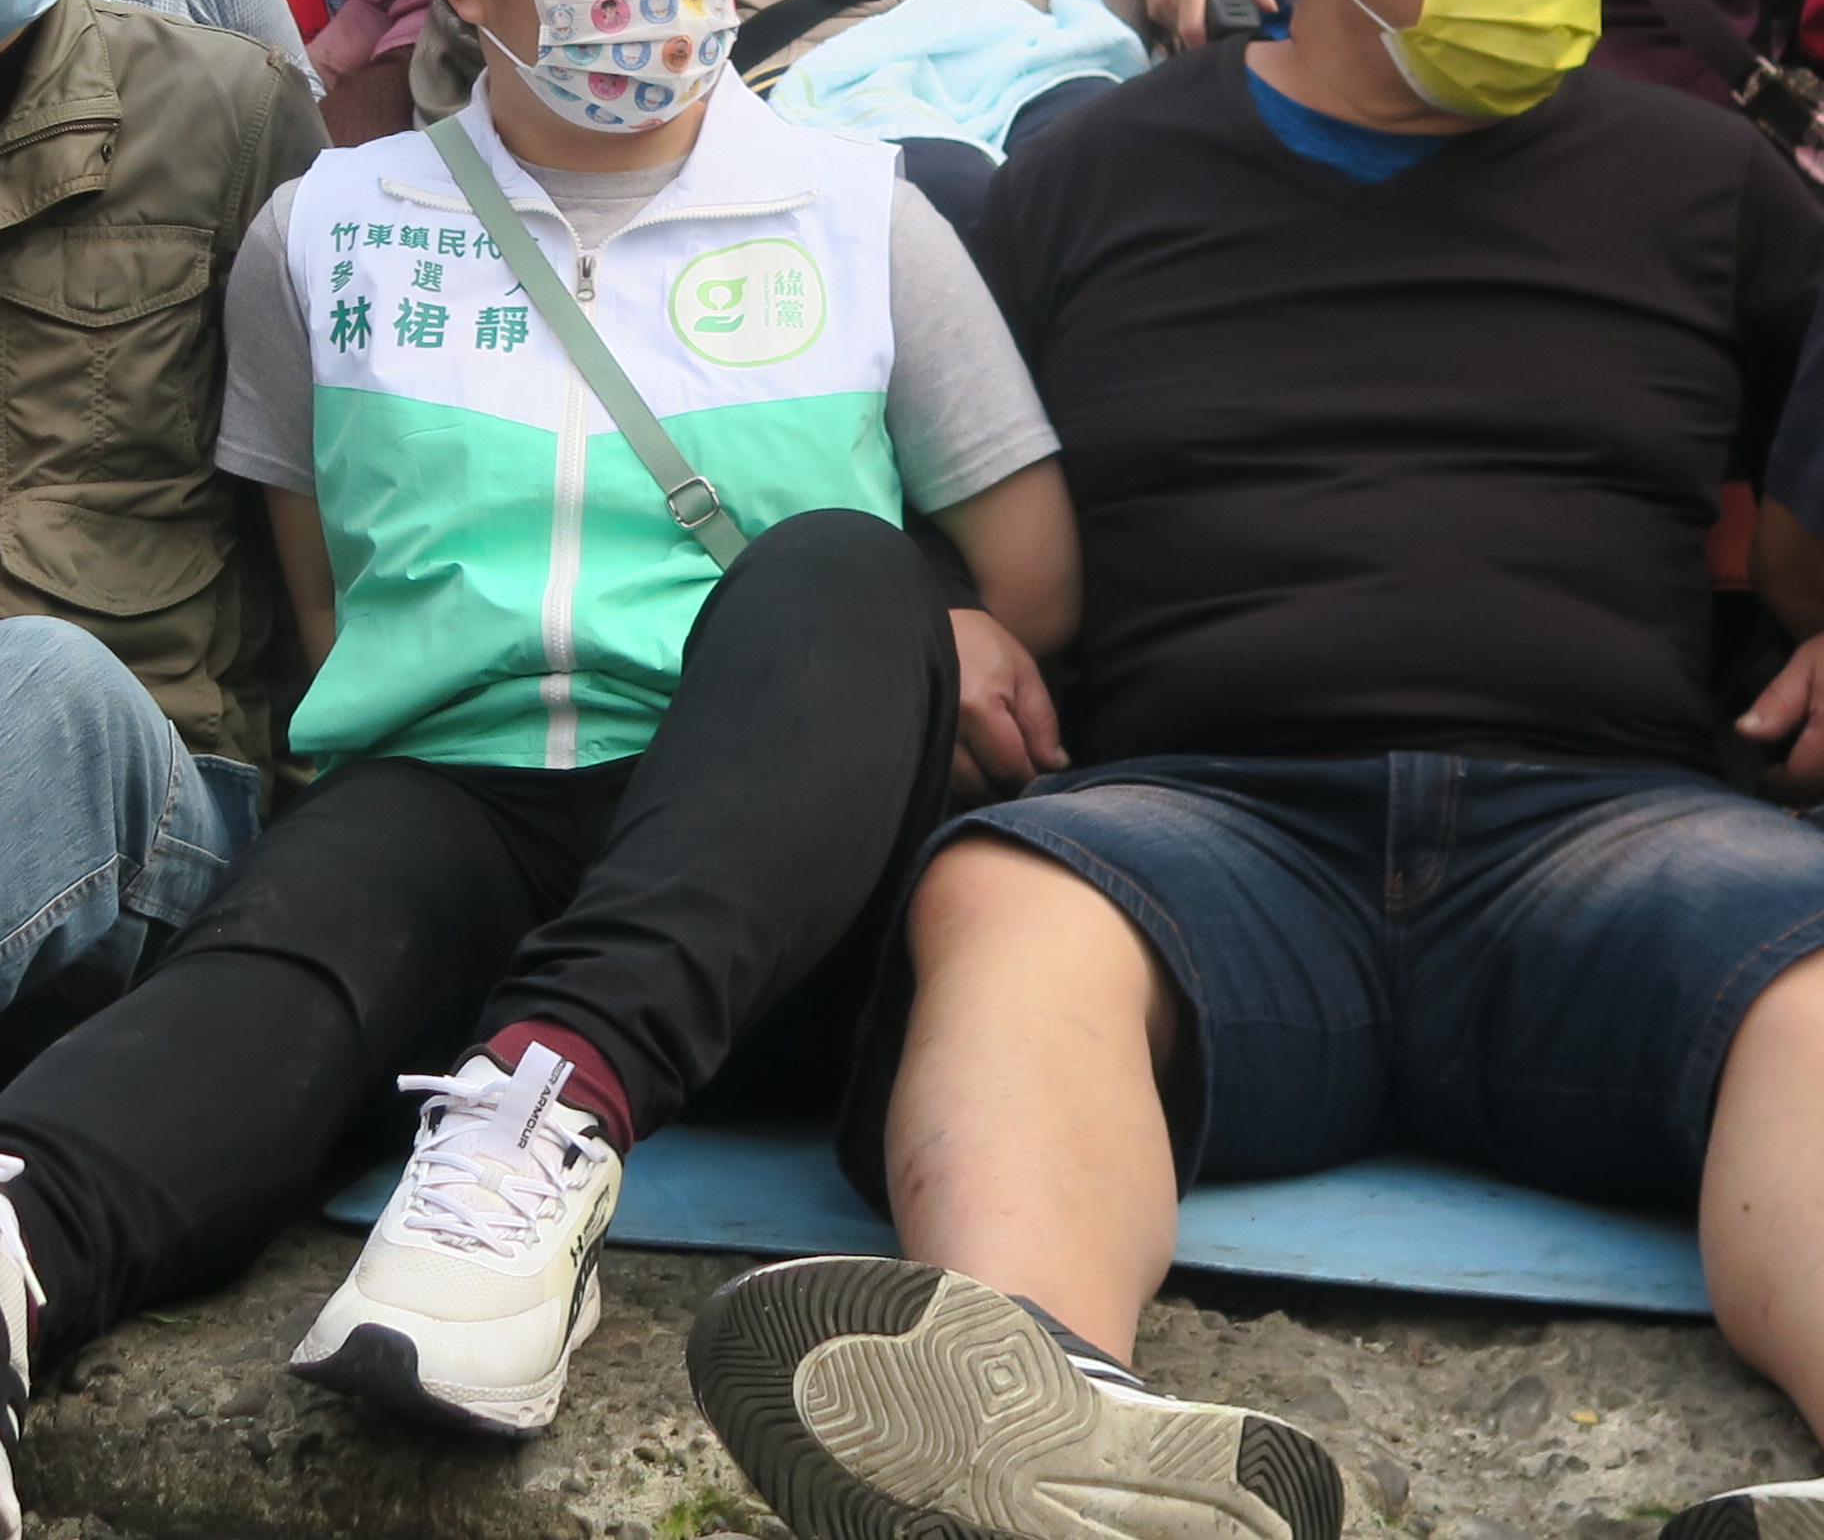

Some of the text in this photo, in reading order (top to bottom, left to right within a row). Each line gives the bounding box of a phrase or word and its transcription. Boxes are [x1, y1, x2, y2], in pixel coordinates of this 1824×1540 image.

[330, 222, 539, 260] 竹東鎮民代
[330, 296, 530, 354] 林裙靜
[517, 1083, 552, 1150] ARMOUR
